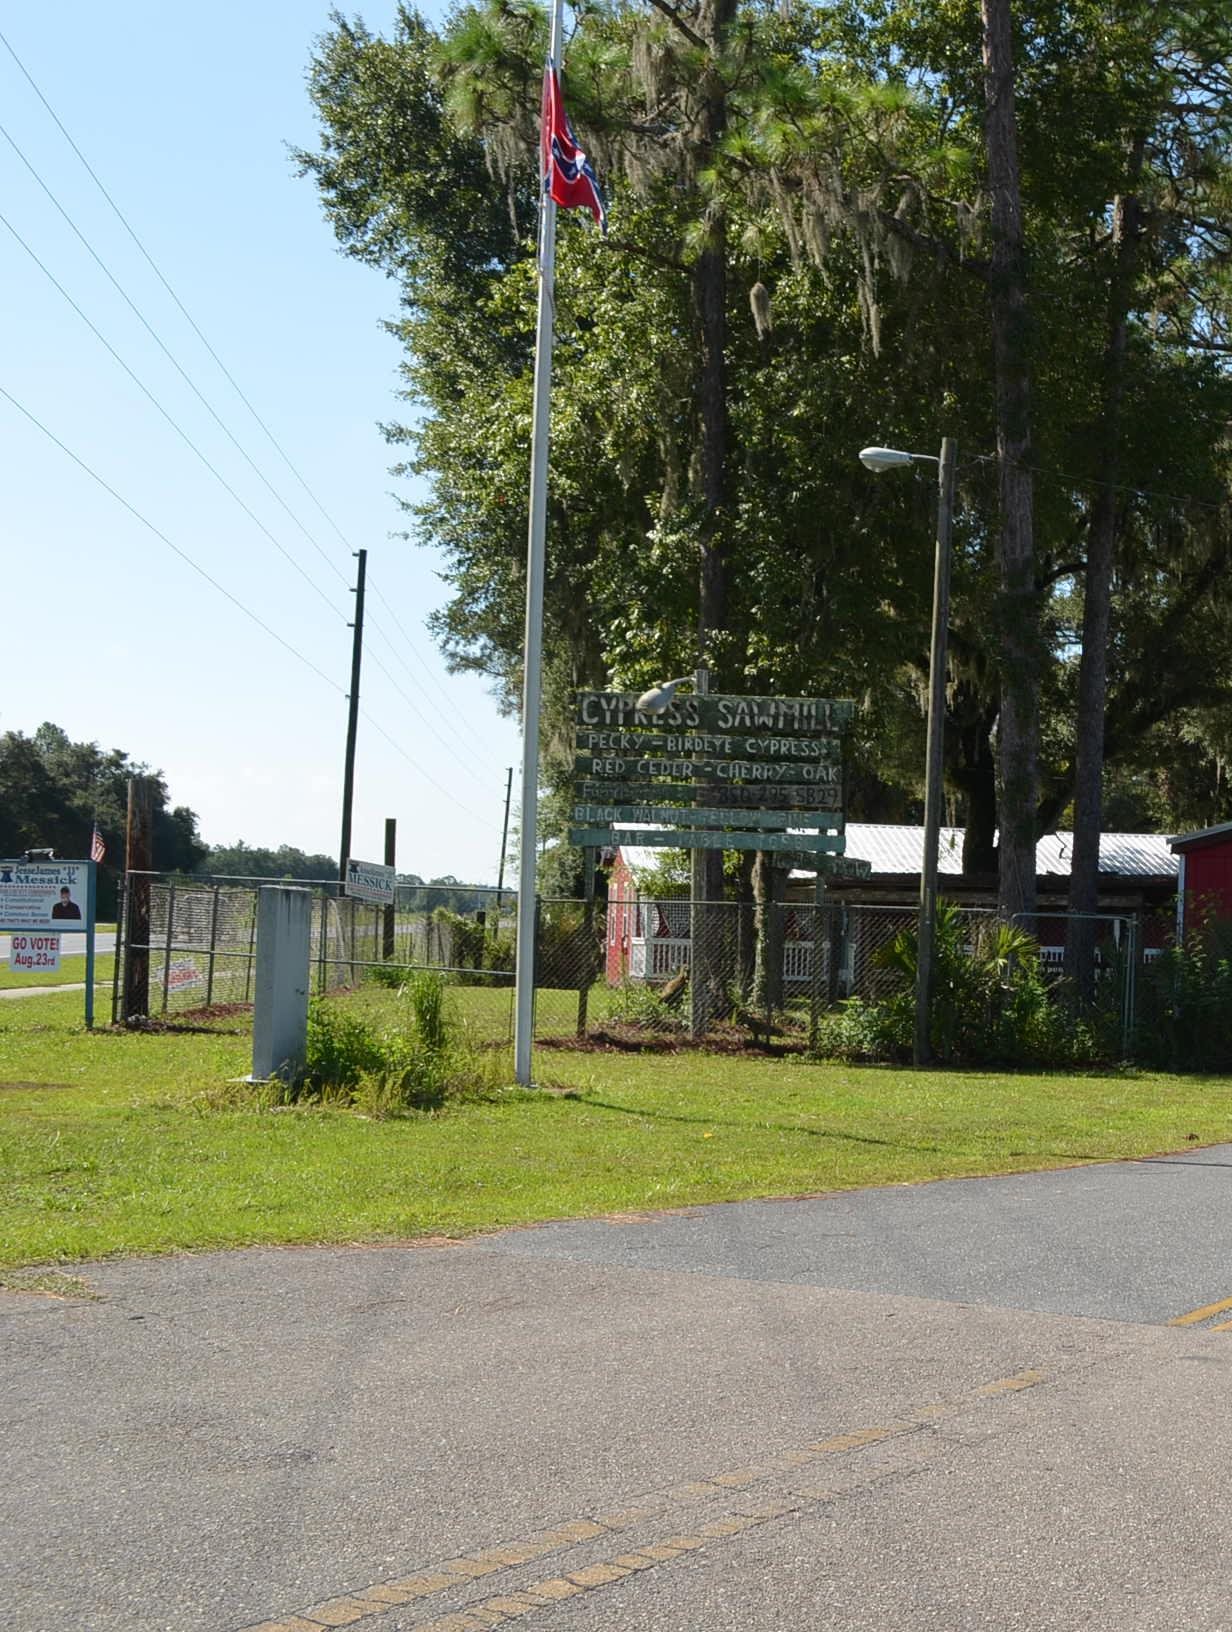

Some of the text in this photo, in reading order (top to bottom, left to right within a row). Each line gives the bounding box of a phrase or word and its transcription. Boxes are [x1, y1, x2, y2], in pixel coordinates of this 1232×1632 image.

[717, 699, 839, 731] SAWMILL
[588, 733, 644, 749] PECKY
[667, 735, 732, 753] BIRDEYE
[592, 758, 625, 775] RED
[637, 760, 693, 777] CEDER
[802, 766, 839, 782] OAK
[574, 806, 622, 822] BLACK
[611, 831, 645, 845] BAR
[15, 875, 77, 885] Messick
[349, 872, 393, 891] MESSICK
[13, 936, 60, 951] GO VOTE!
[14, 952, 56, 969] Aug.23rd
